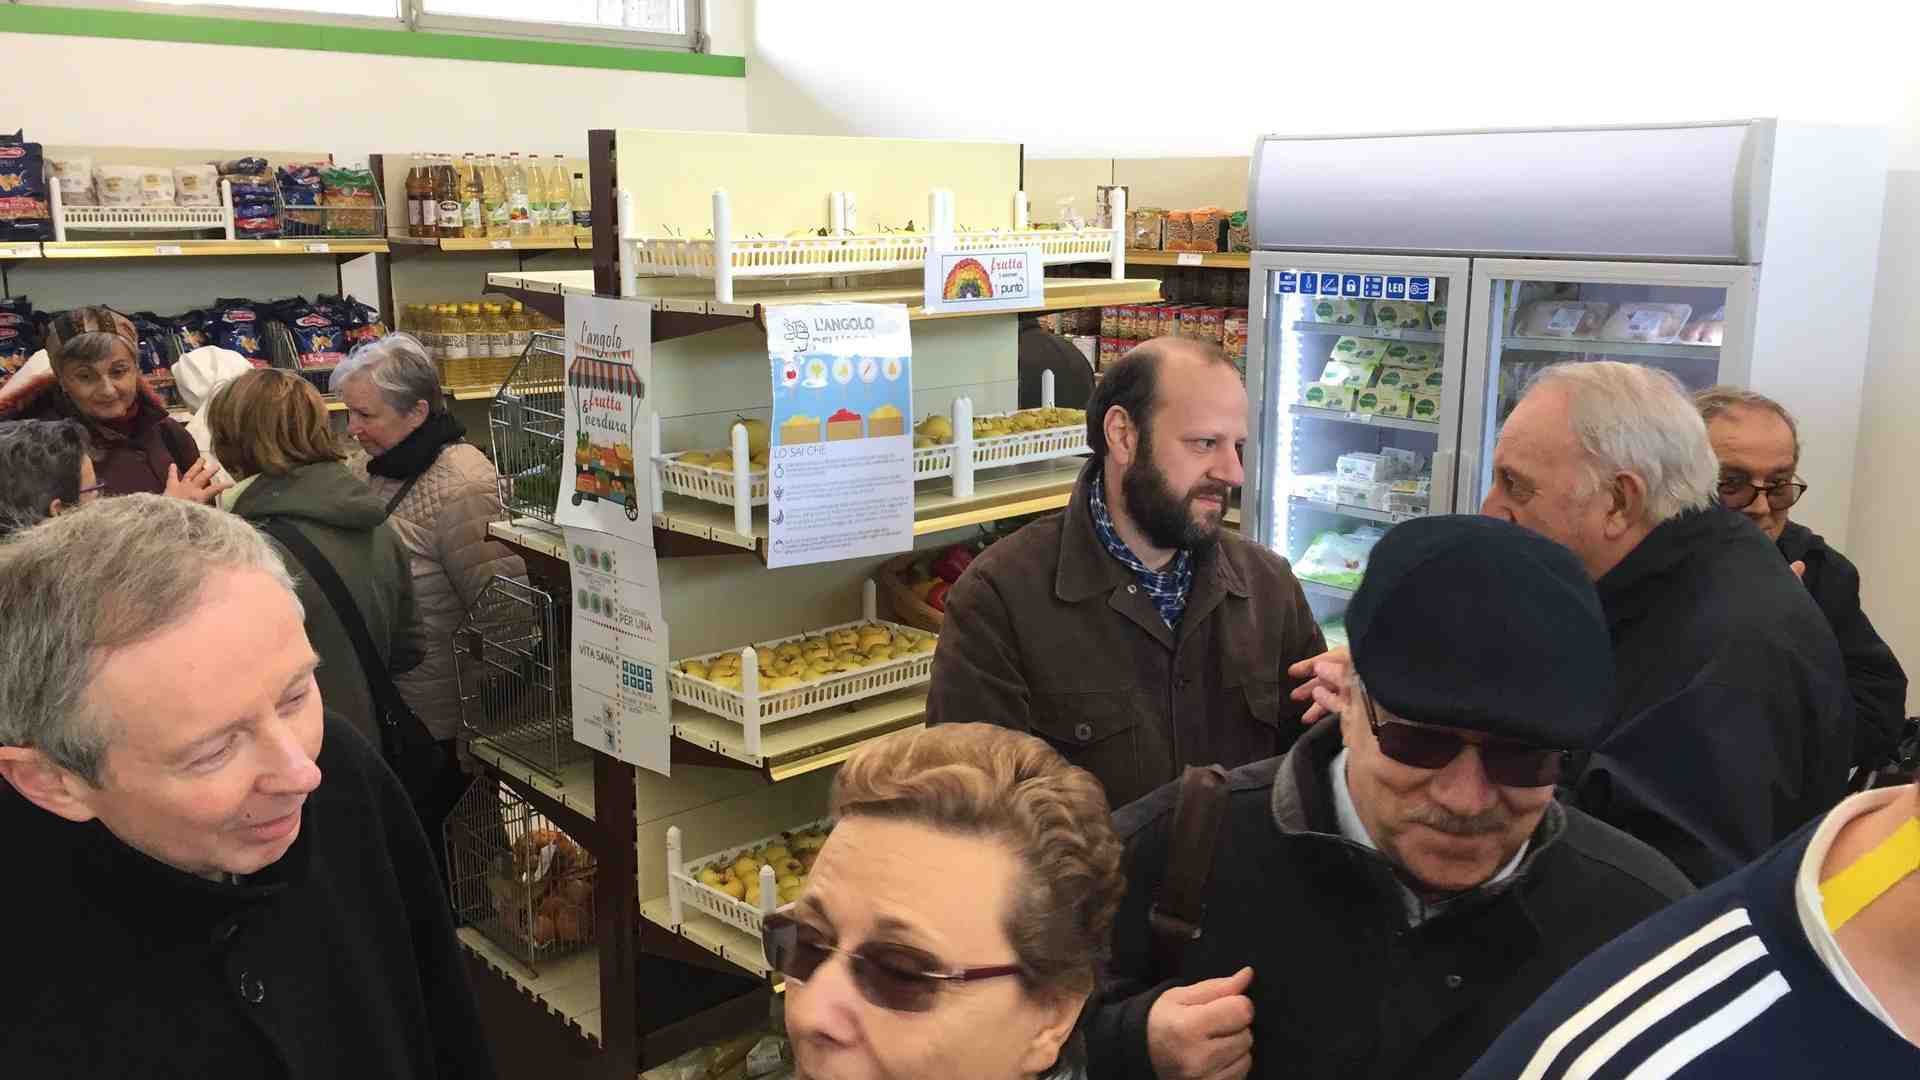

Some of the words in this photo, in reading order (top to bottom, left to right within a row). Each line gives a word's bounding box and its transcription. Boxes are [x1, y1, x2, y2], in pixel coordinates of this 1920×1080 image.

[991, 257, 1023, 273] frutta
[1001, 283, 1023, 295] punto
[1388, 283, 1404, 293] LED
[814, 318, 874, 331] L'ANGOLO
[581, 321, 622, 358] l'angolo
[589, 391, 624, 413] frutta
[585, 412, 627, 433] verdura
[619, 613, 633, 625] PER
[578, 646, 595, 660] VITA
[595, 650, 616, 666] SANA
